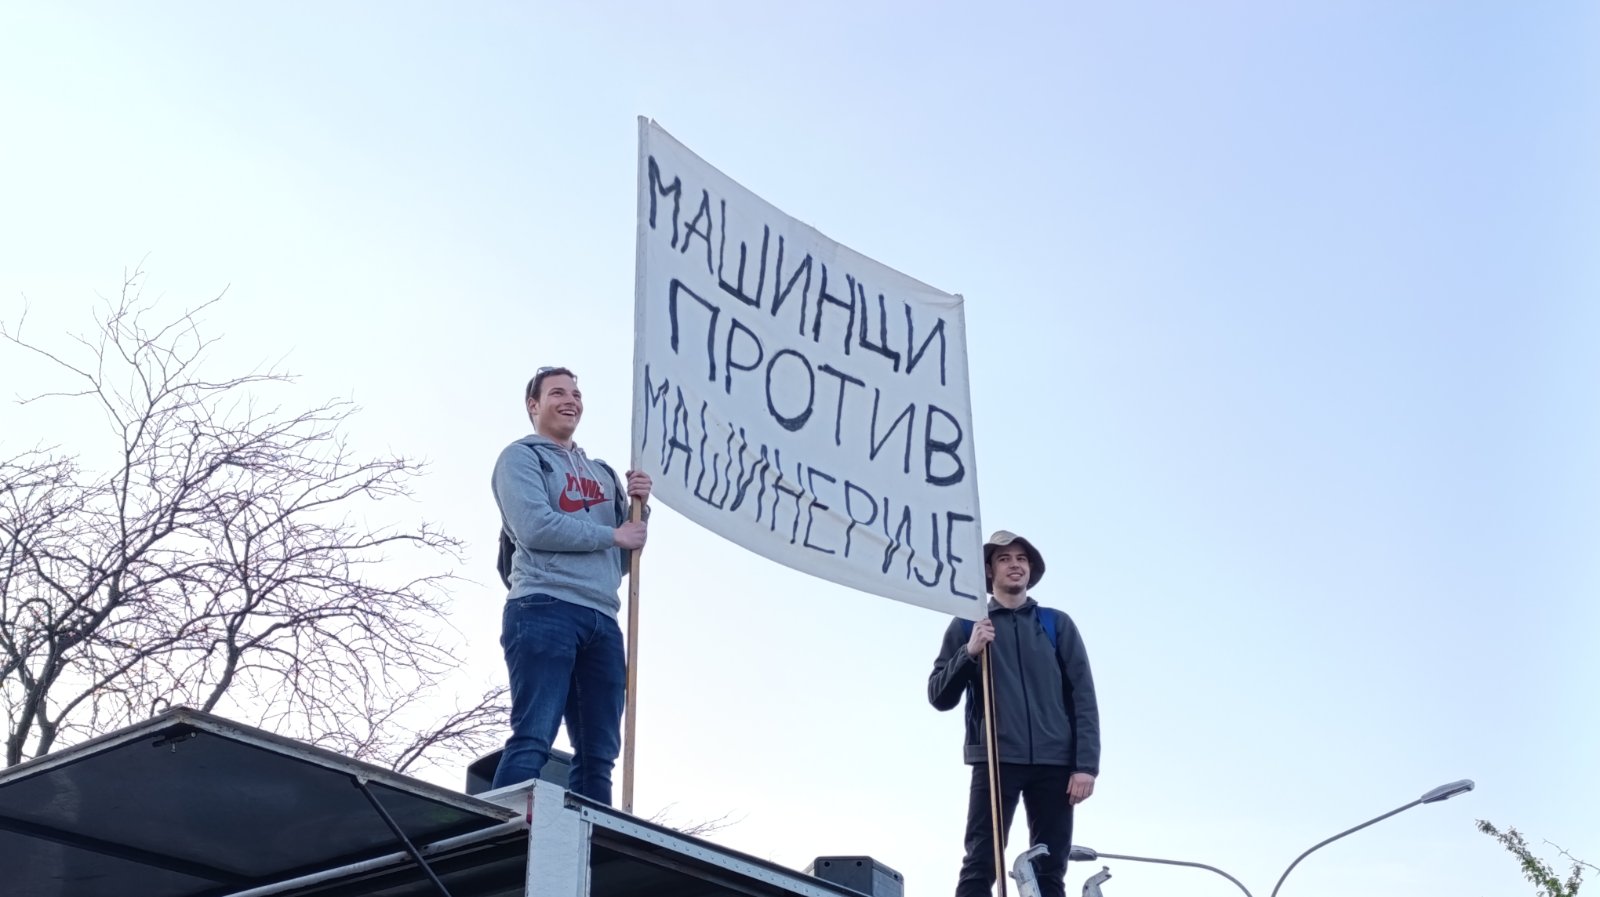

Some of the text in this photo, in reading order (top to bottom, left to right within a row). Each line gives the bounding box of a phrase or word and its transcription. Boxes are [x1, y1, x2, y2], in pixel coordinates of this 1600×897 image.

[648, 155, 946, 386] МАШИНЦИ
[669, 278, 965, 486] ПРОТИВ
[642, 364, 979, 600] МАШИНЕРИЈЕ
